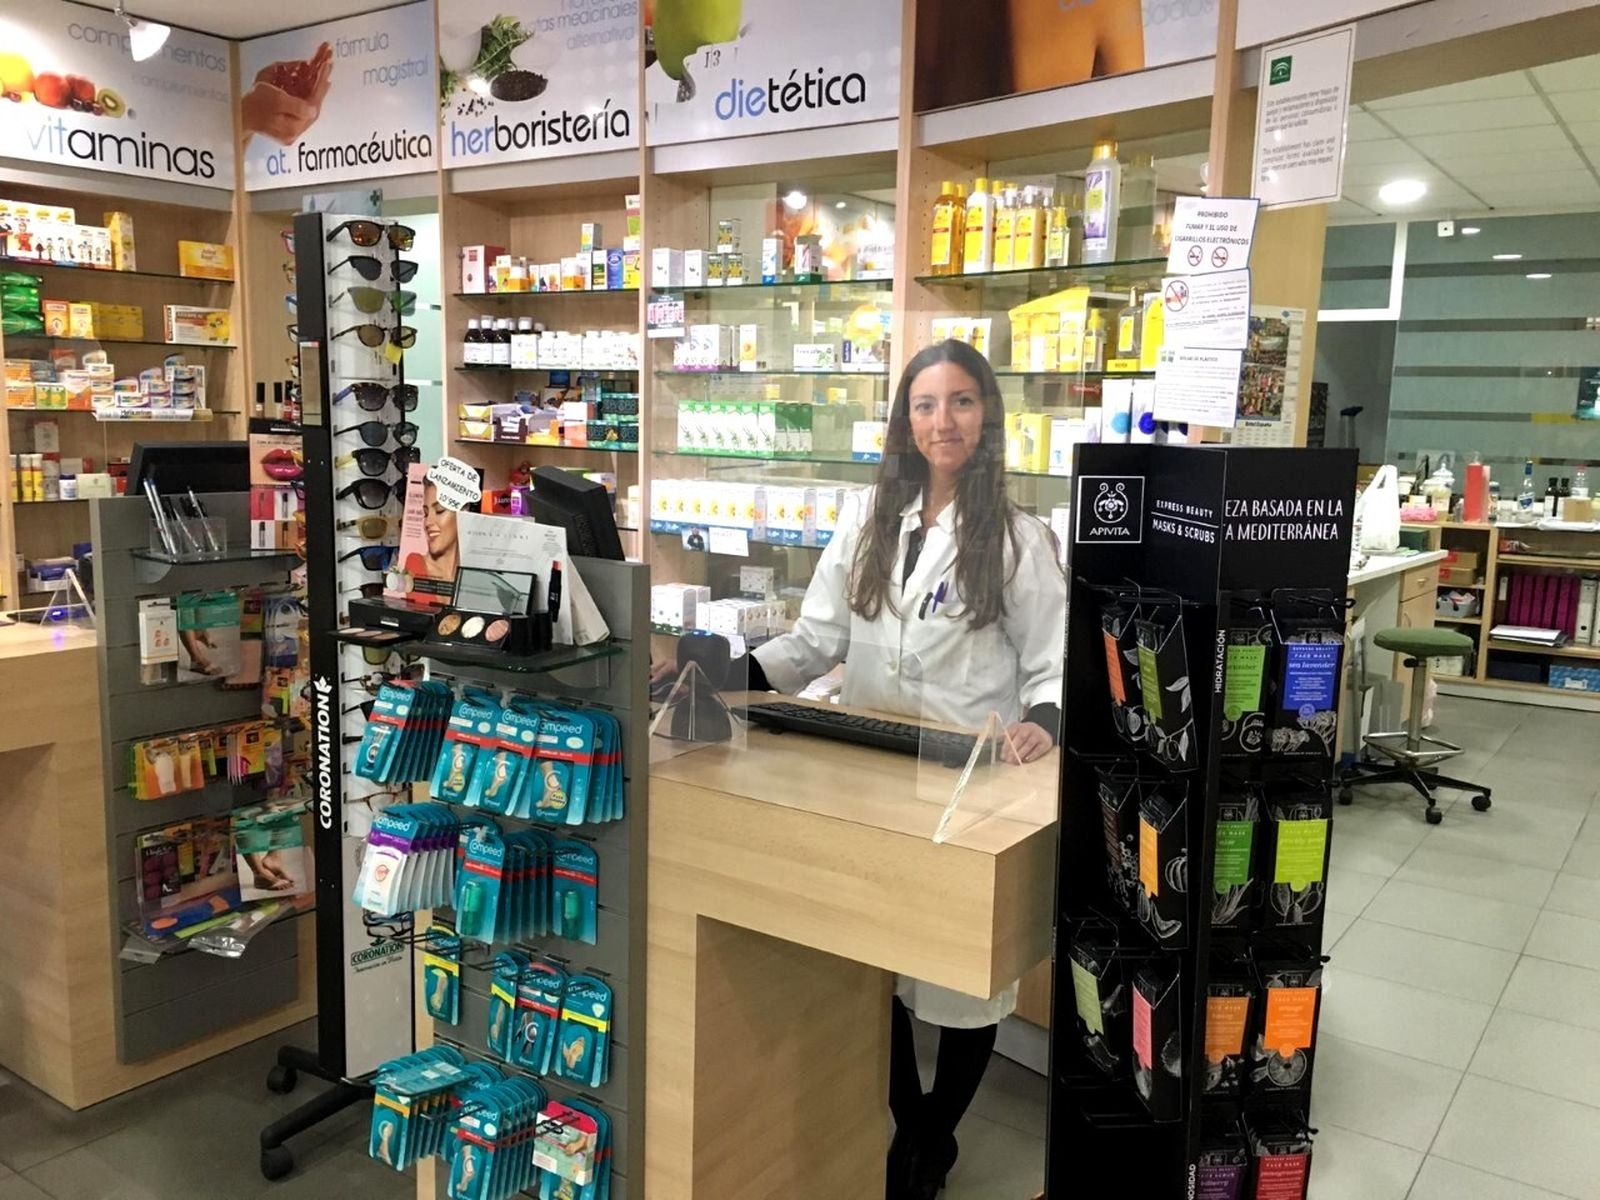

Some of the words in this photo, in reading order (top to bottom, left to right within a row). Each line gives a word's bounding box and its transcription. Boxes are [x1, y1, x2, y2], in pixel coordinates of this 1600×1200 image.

[68, 23, 226, 72] compmentos
[335, 30, 390, 59] fórmula
[362, 56, 430, 88] magistral
[714, 66, 866, 121] dietética
[450, 99, 631, 157] herboristería
[26, 117, 215, 179] vitaminas
[266, 154, 293, 176] at.
[298, 131, 432, 173] farmacéutica
[1175, 235, 1206, 243] CIGARRILLOS
[1207, 236, 1249, 246] ELECTRÓNICOS
[440, 459, 466, 475] OFERTA
[467, 471, 478, 483] DE
[430, 471, 479, 501] LANZAMIENTO
[1156, 499, 1184, 513] EXPRESS
[1186, 505, 1213, 518] BEAUTY
[1252, 499, 1303, 517] BASADA
[1306, 499, 1325, 517] EN
[1327, 499, 1344, 517] LA
[1089, 527, 1131, 536] APIVITA
[1152, 518, 1176, 534] MASKS
[1177, 525, 1182, 536] &
[1184, 525, 1216, 544] SCRUBS
[1237, 519, 1339, 540] MEDITERRÁNEA
[1214, 629, 1227, 693] HIDRATACIÓN
[1301, 661, 1335, 669] lavender
[458, 703, 494, 720] Compeed
[502, 708, 538, 727] Compeed
[317, 694, 332, 829] CORONATION
[469, 838, 502, 857] Compeed
[352, 942, 404, 963] CORONATION
